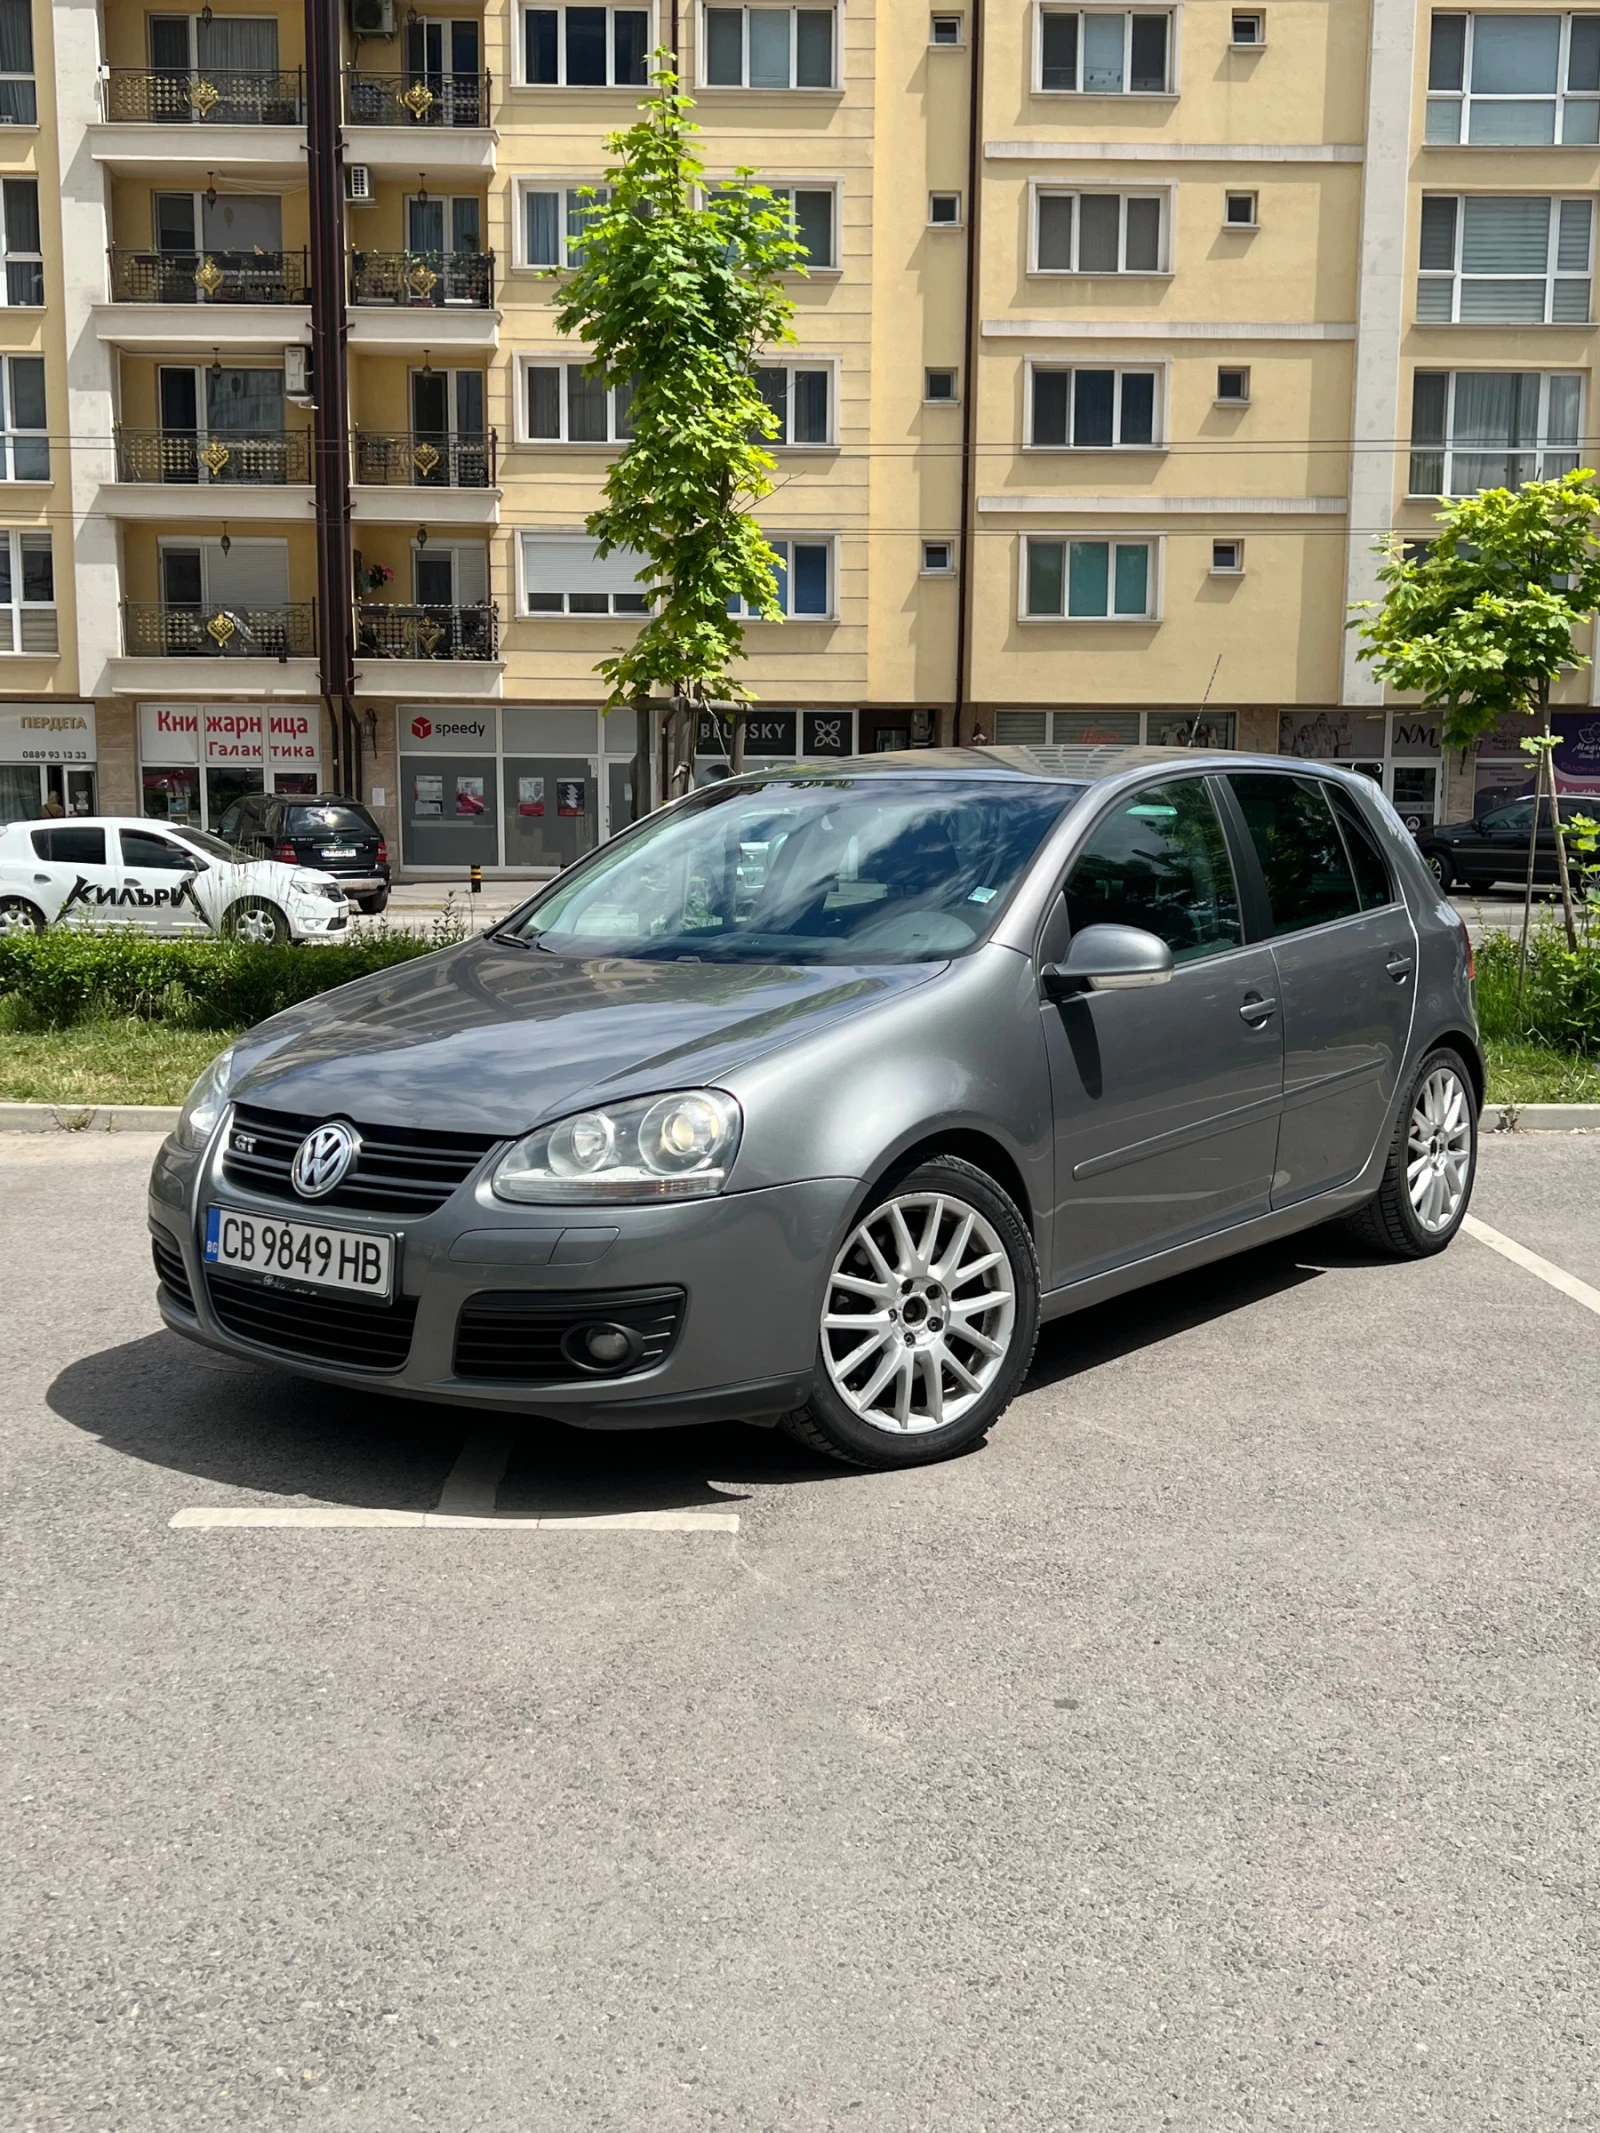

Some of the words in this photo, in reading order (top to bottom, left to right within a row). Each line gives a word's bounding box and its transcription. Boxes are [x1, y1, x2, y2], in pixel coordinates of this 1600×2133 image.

[21, 715, 87, 731] ПЕРДЕТА
[157, 710, 308, 740] Книжарница
[435, 720, 486, 738] speedy
[700, 723, 786, 739] BLUSKY
[1394, 723, 1440, 748] NM
[22, 750, 46, 759] 0889
[48, 750, 60, 759] 93
[63, 750, 73, 760] 13
[75, 751, 87, 760] 33
[208, 741, 315, 758] Галактика
[234, 1134, 257, 1154] GT
[206, 1240, 218, 1254] BG
[222, 1218, 255, 1262] CB
[262, 1225, 332, 1277] 9849
[338, 1237, 382, 1285] HB
